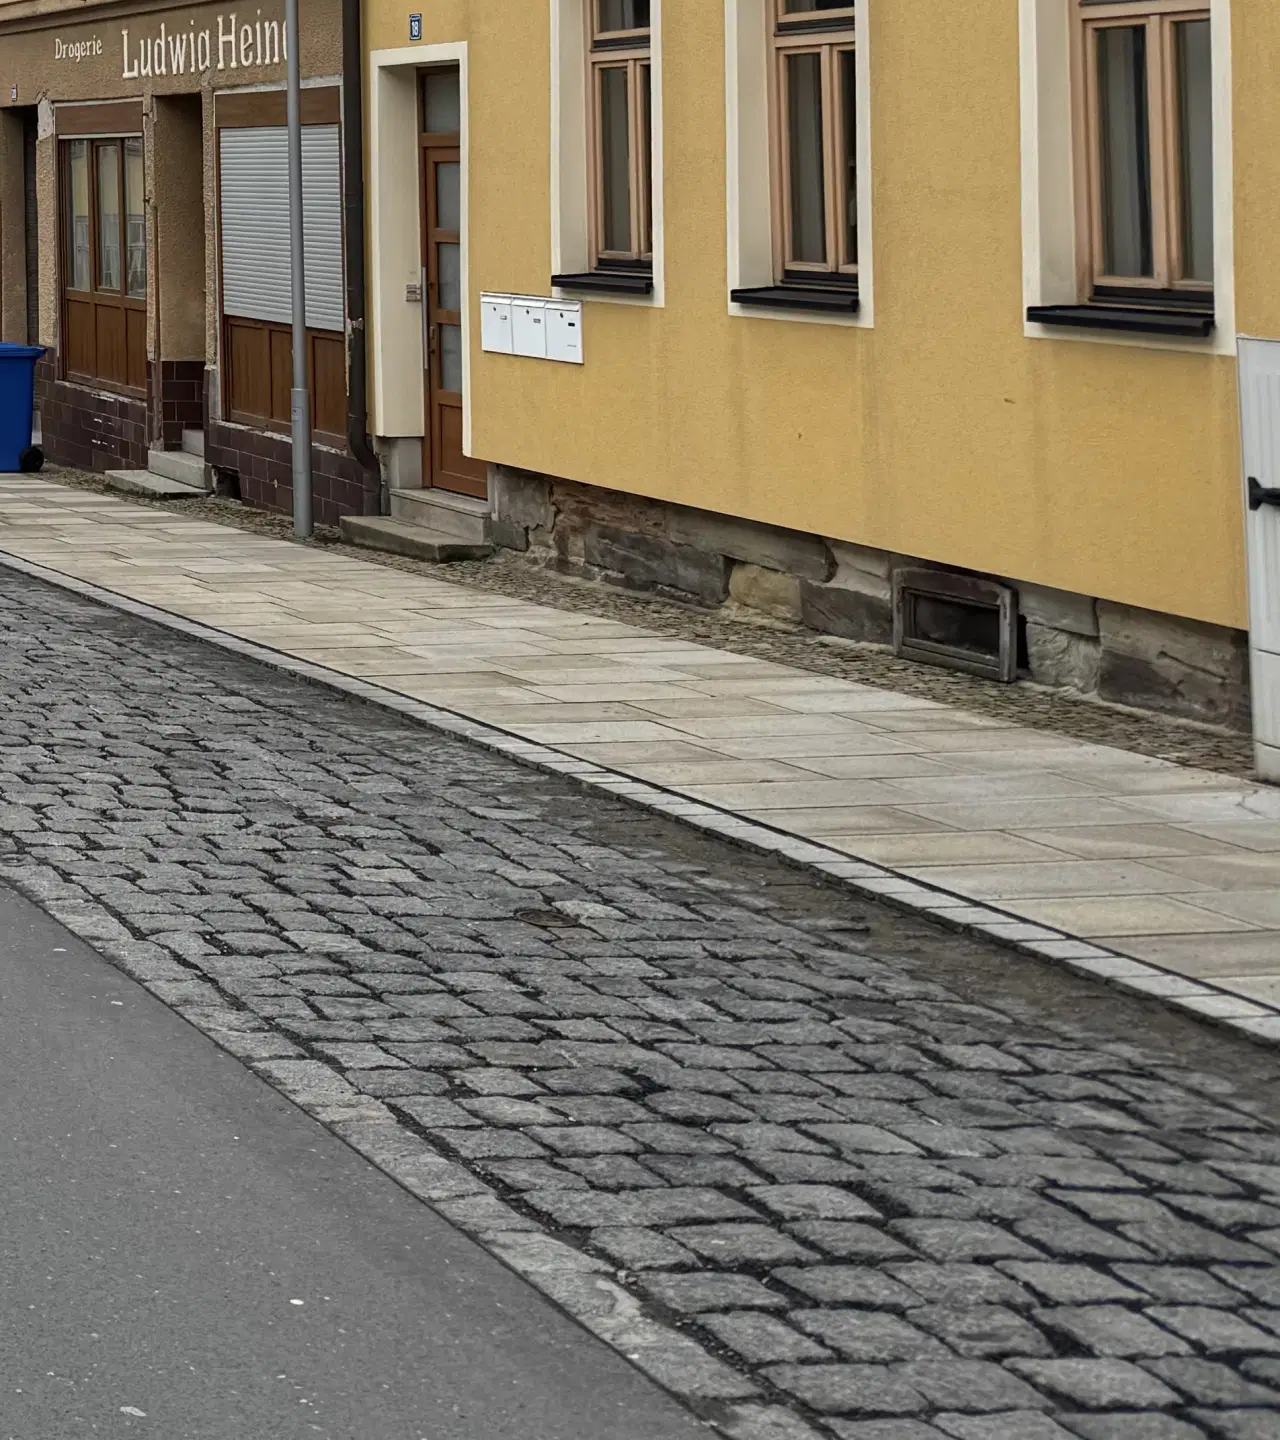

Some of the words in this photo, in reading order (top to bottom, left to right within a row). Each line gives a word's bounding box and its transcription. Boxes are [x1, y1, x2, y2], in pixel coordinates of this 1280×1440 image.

[54, 34, 103, 64] Drogerie
[216, 9, 288, 71] Hein
[412, 21, 419, 36] 18
